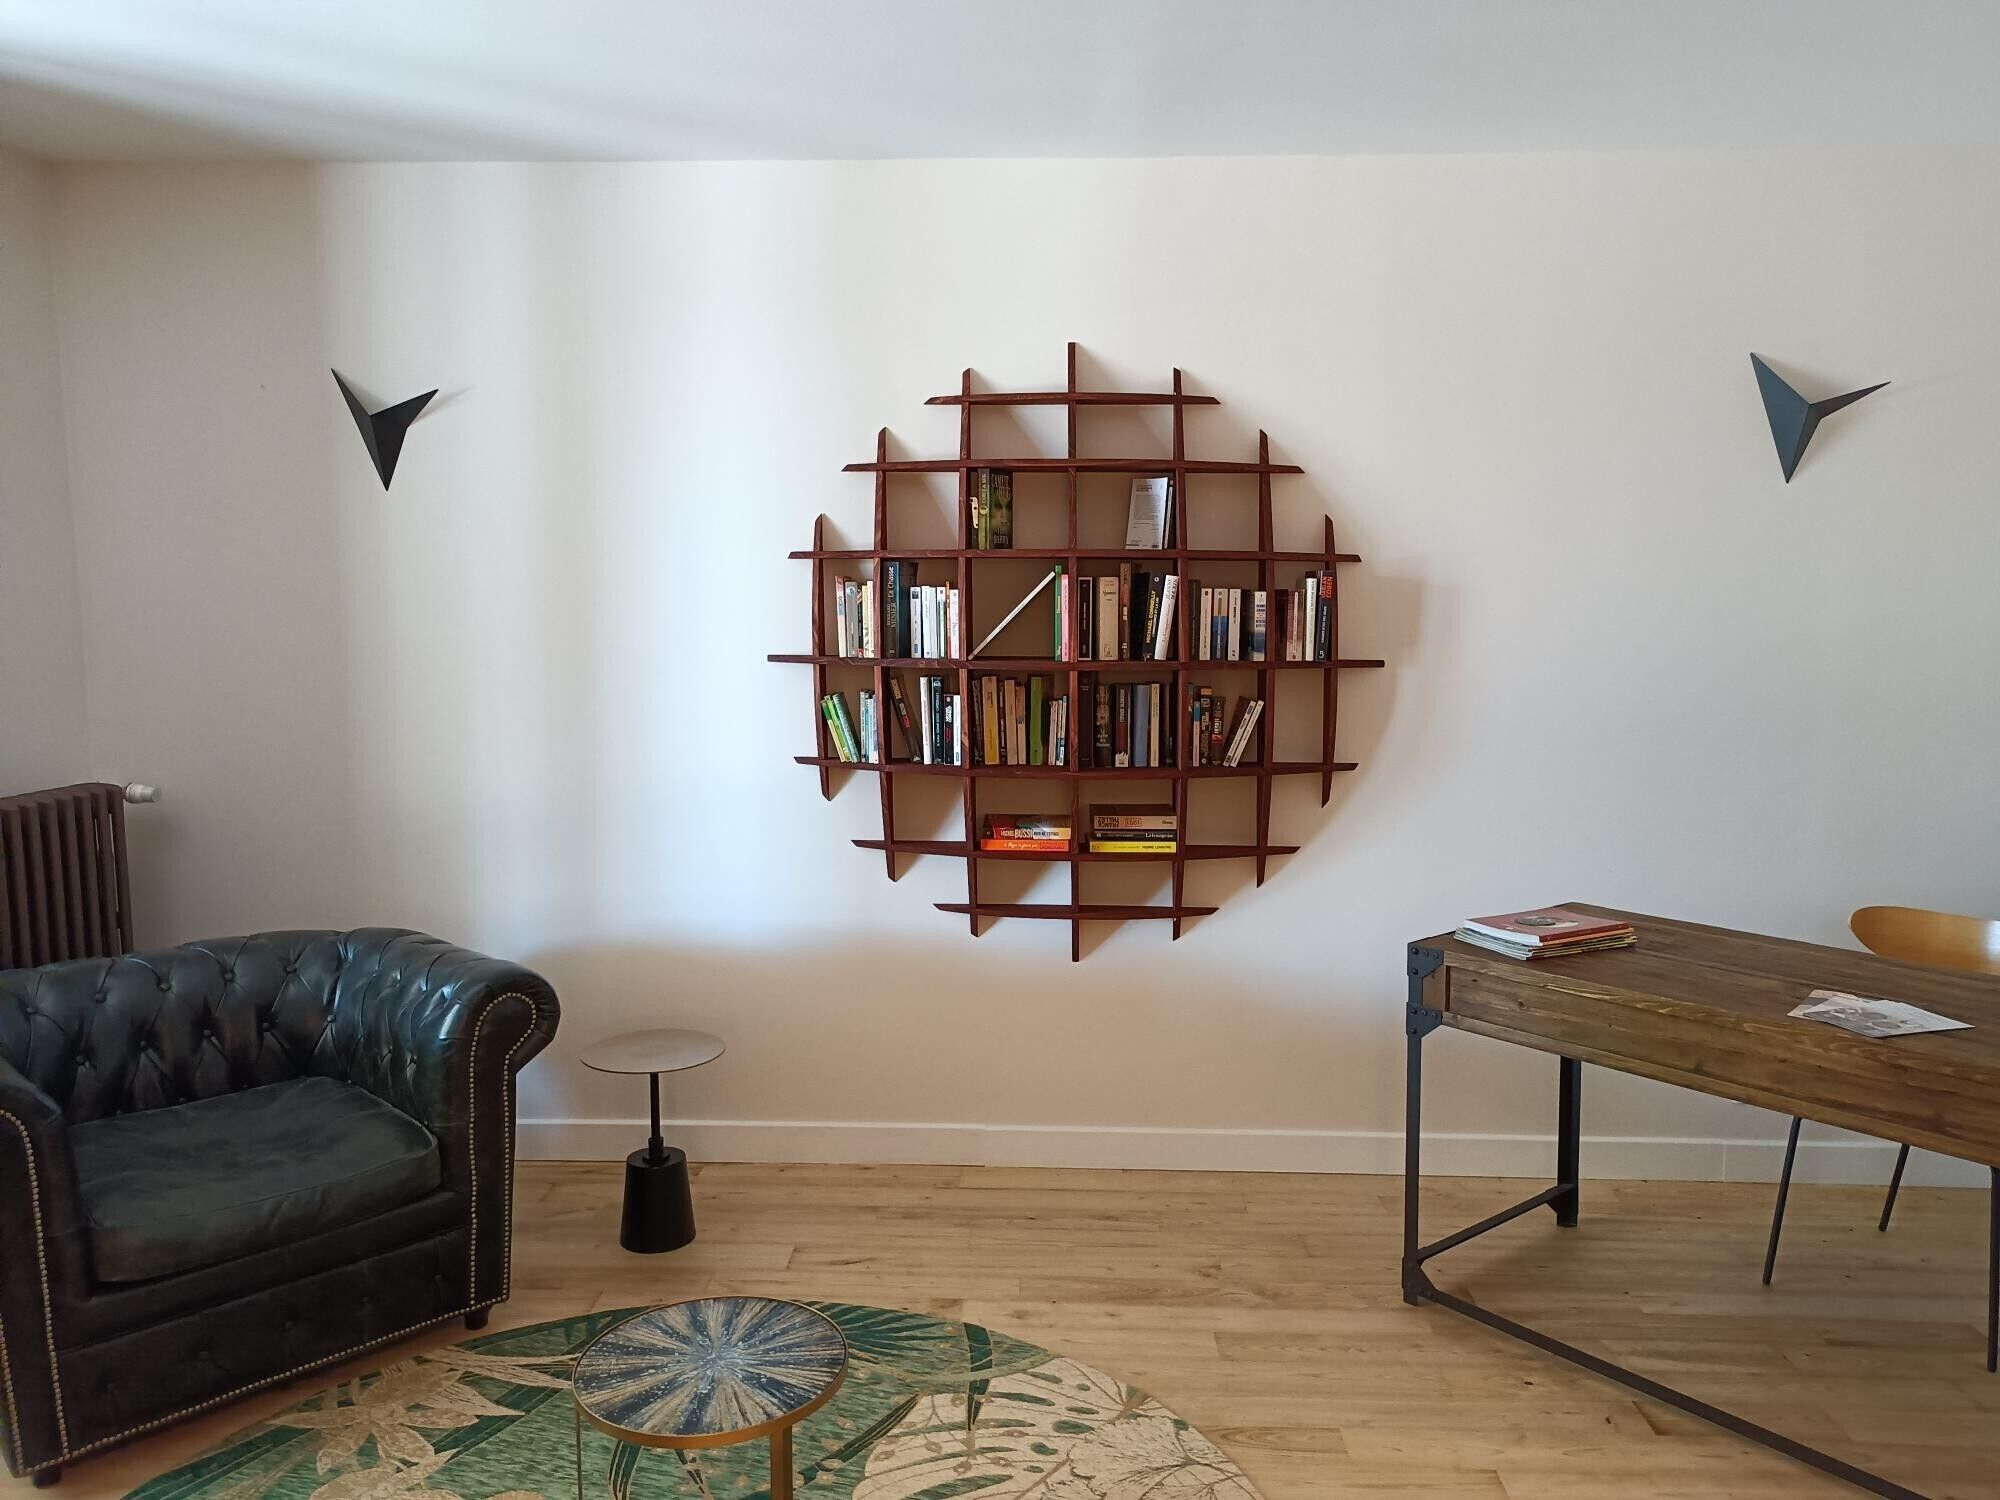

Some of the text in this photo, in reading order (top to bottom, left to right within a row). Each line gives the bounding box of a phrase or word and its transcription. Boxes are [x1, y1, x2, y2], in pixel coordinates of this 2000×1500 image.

[1326, 576, 1334, 598] COBEN
[1148, 590, 1157, 619] CONNELLY
[1145, 619, 1153, 643] MICHAEL
[1014, 828, 1033, 839] BUSSI
